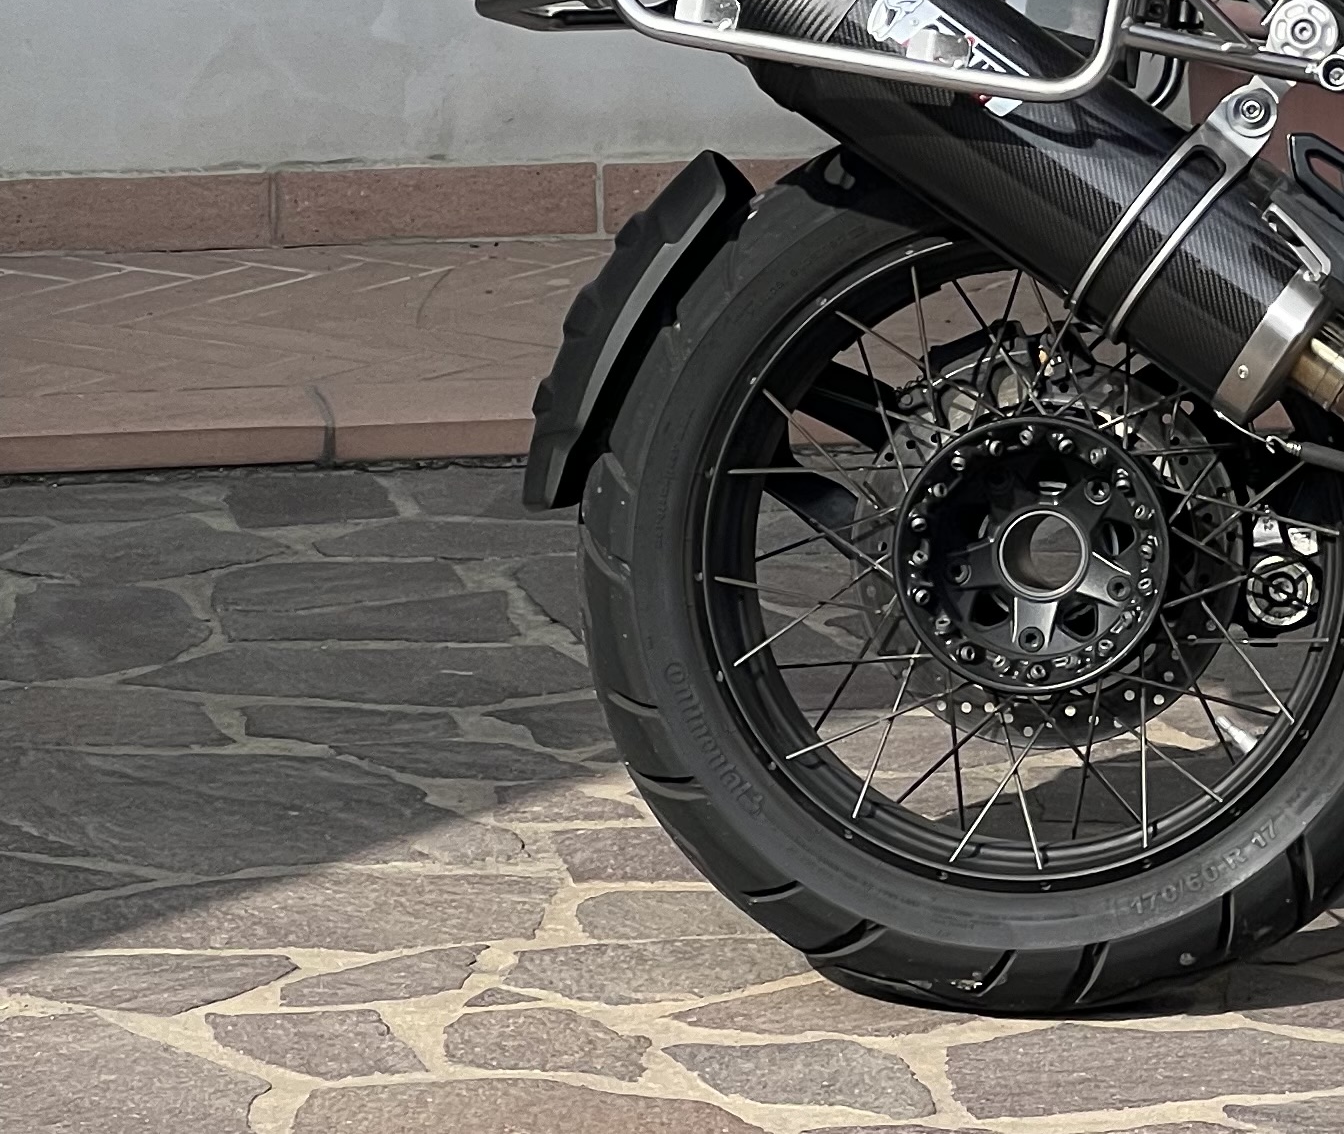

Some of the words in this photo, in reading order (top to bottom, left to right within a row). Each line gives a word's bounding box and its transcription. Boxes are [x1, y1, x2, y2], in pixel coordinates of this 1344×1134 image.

[1130, 864, 1219, 914] 170/60
[1223, 847, 1247, 869] R
[1250, 819, 1280, 849] 17
